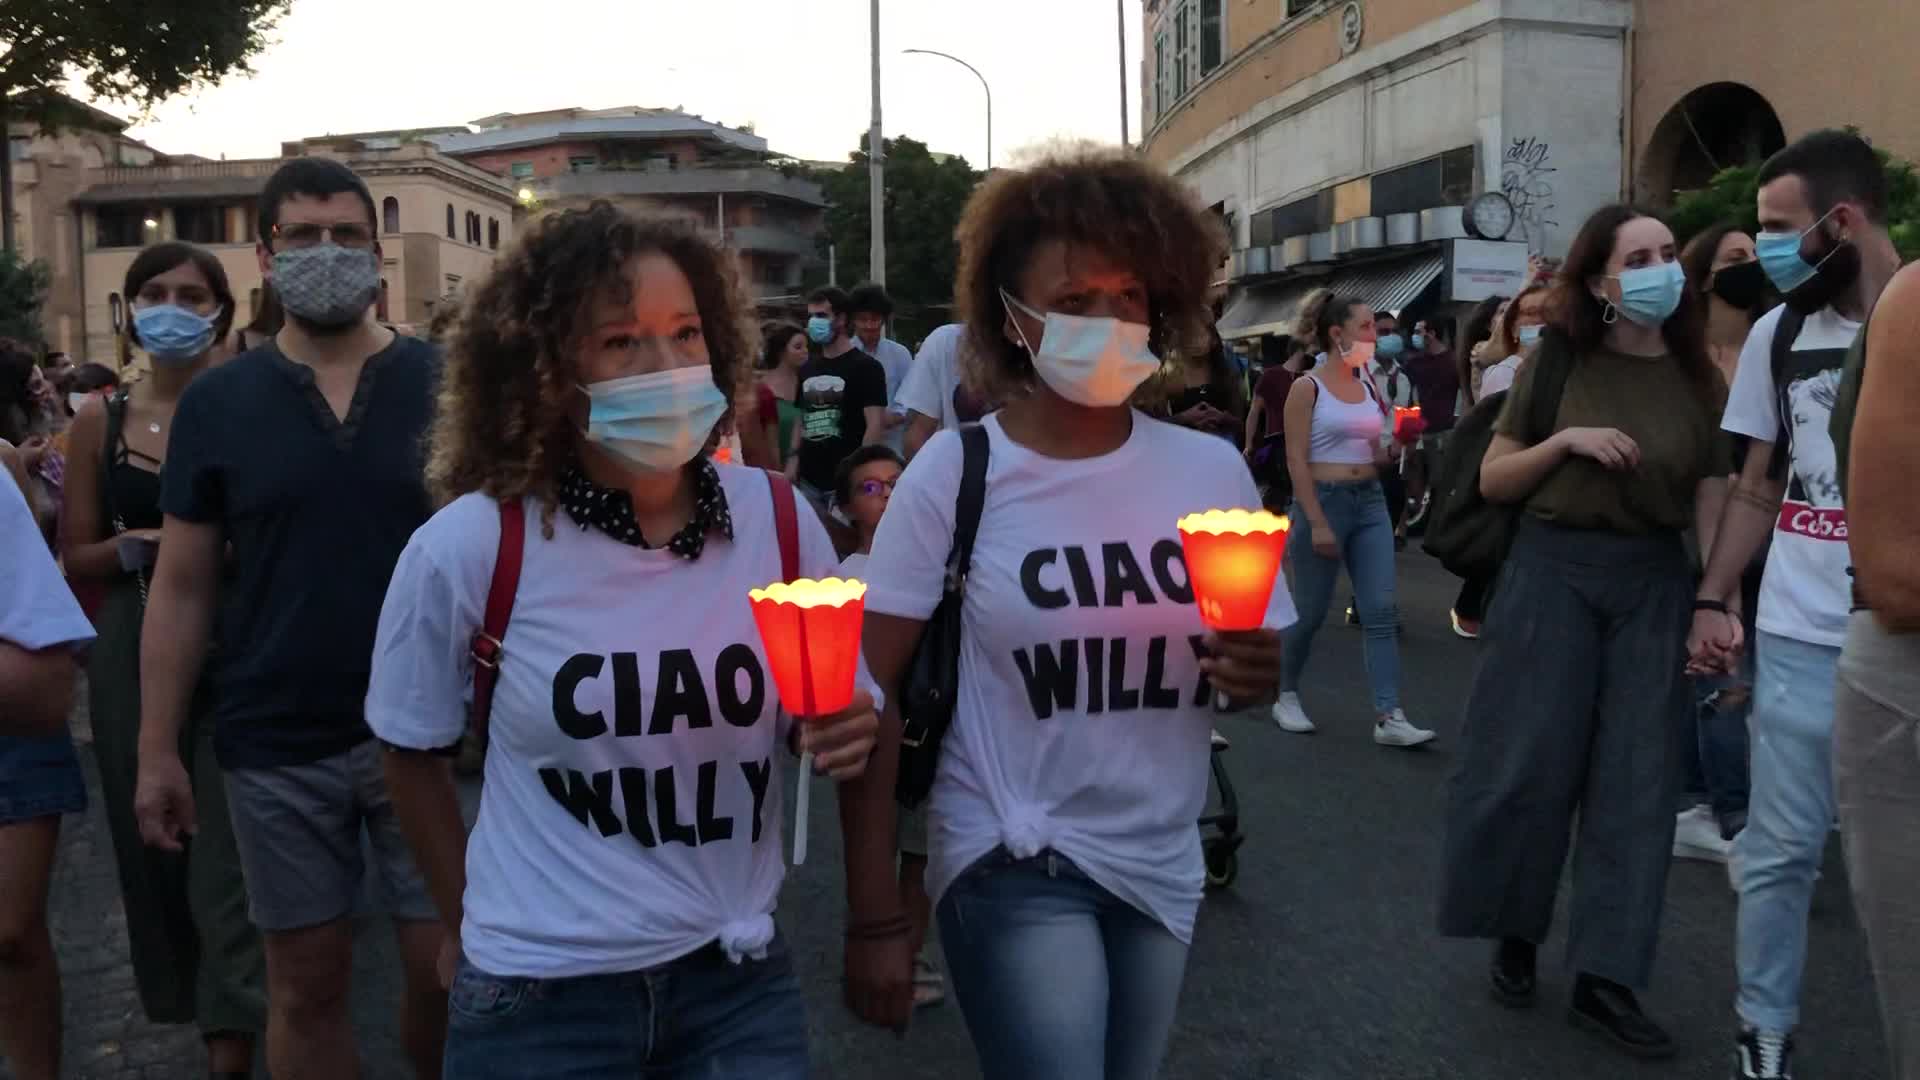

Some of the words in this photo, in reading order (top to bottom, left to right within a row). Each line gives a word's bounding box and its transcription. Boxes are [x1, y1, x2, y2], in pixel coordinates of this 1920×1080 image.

[1019, 539, 1197, 610] CIAO
[552, 643, 765, 740] CIAO
[538, 757, 770, 848] WILLY
